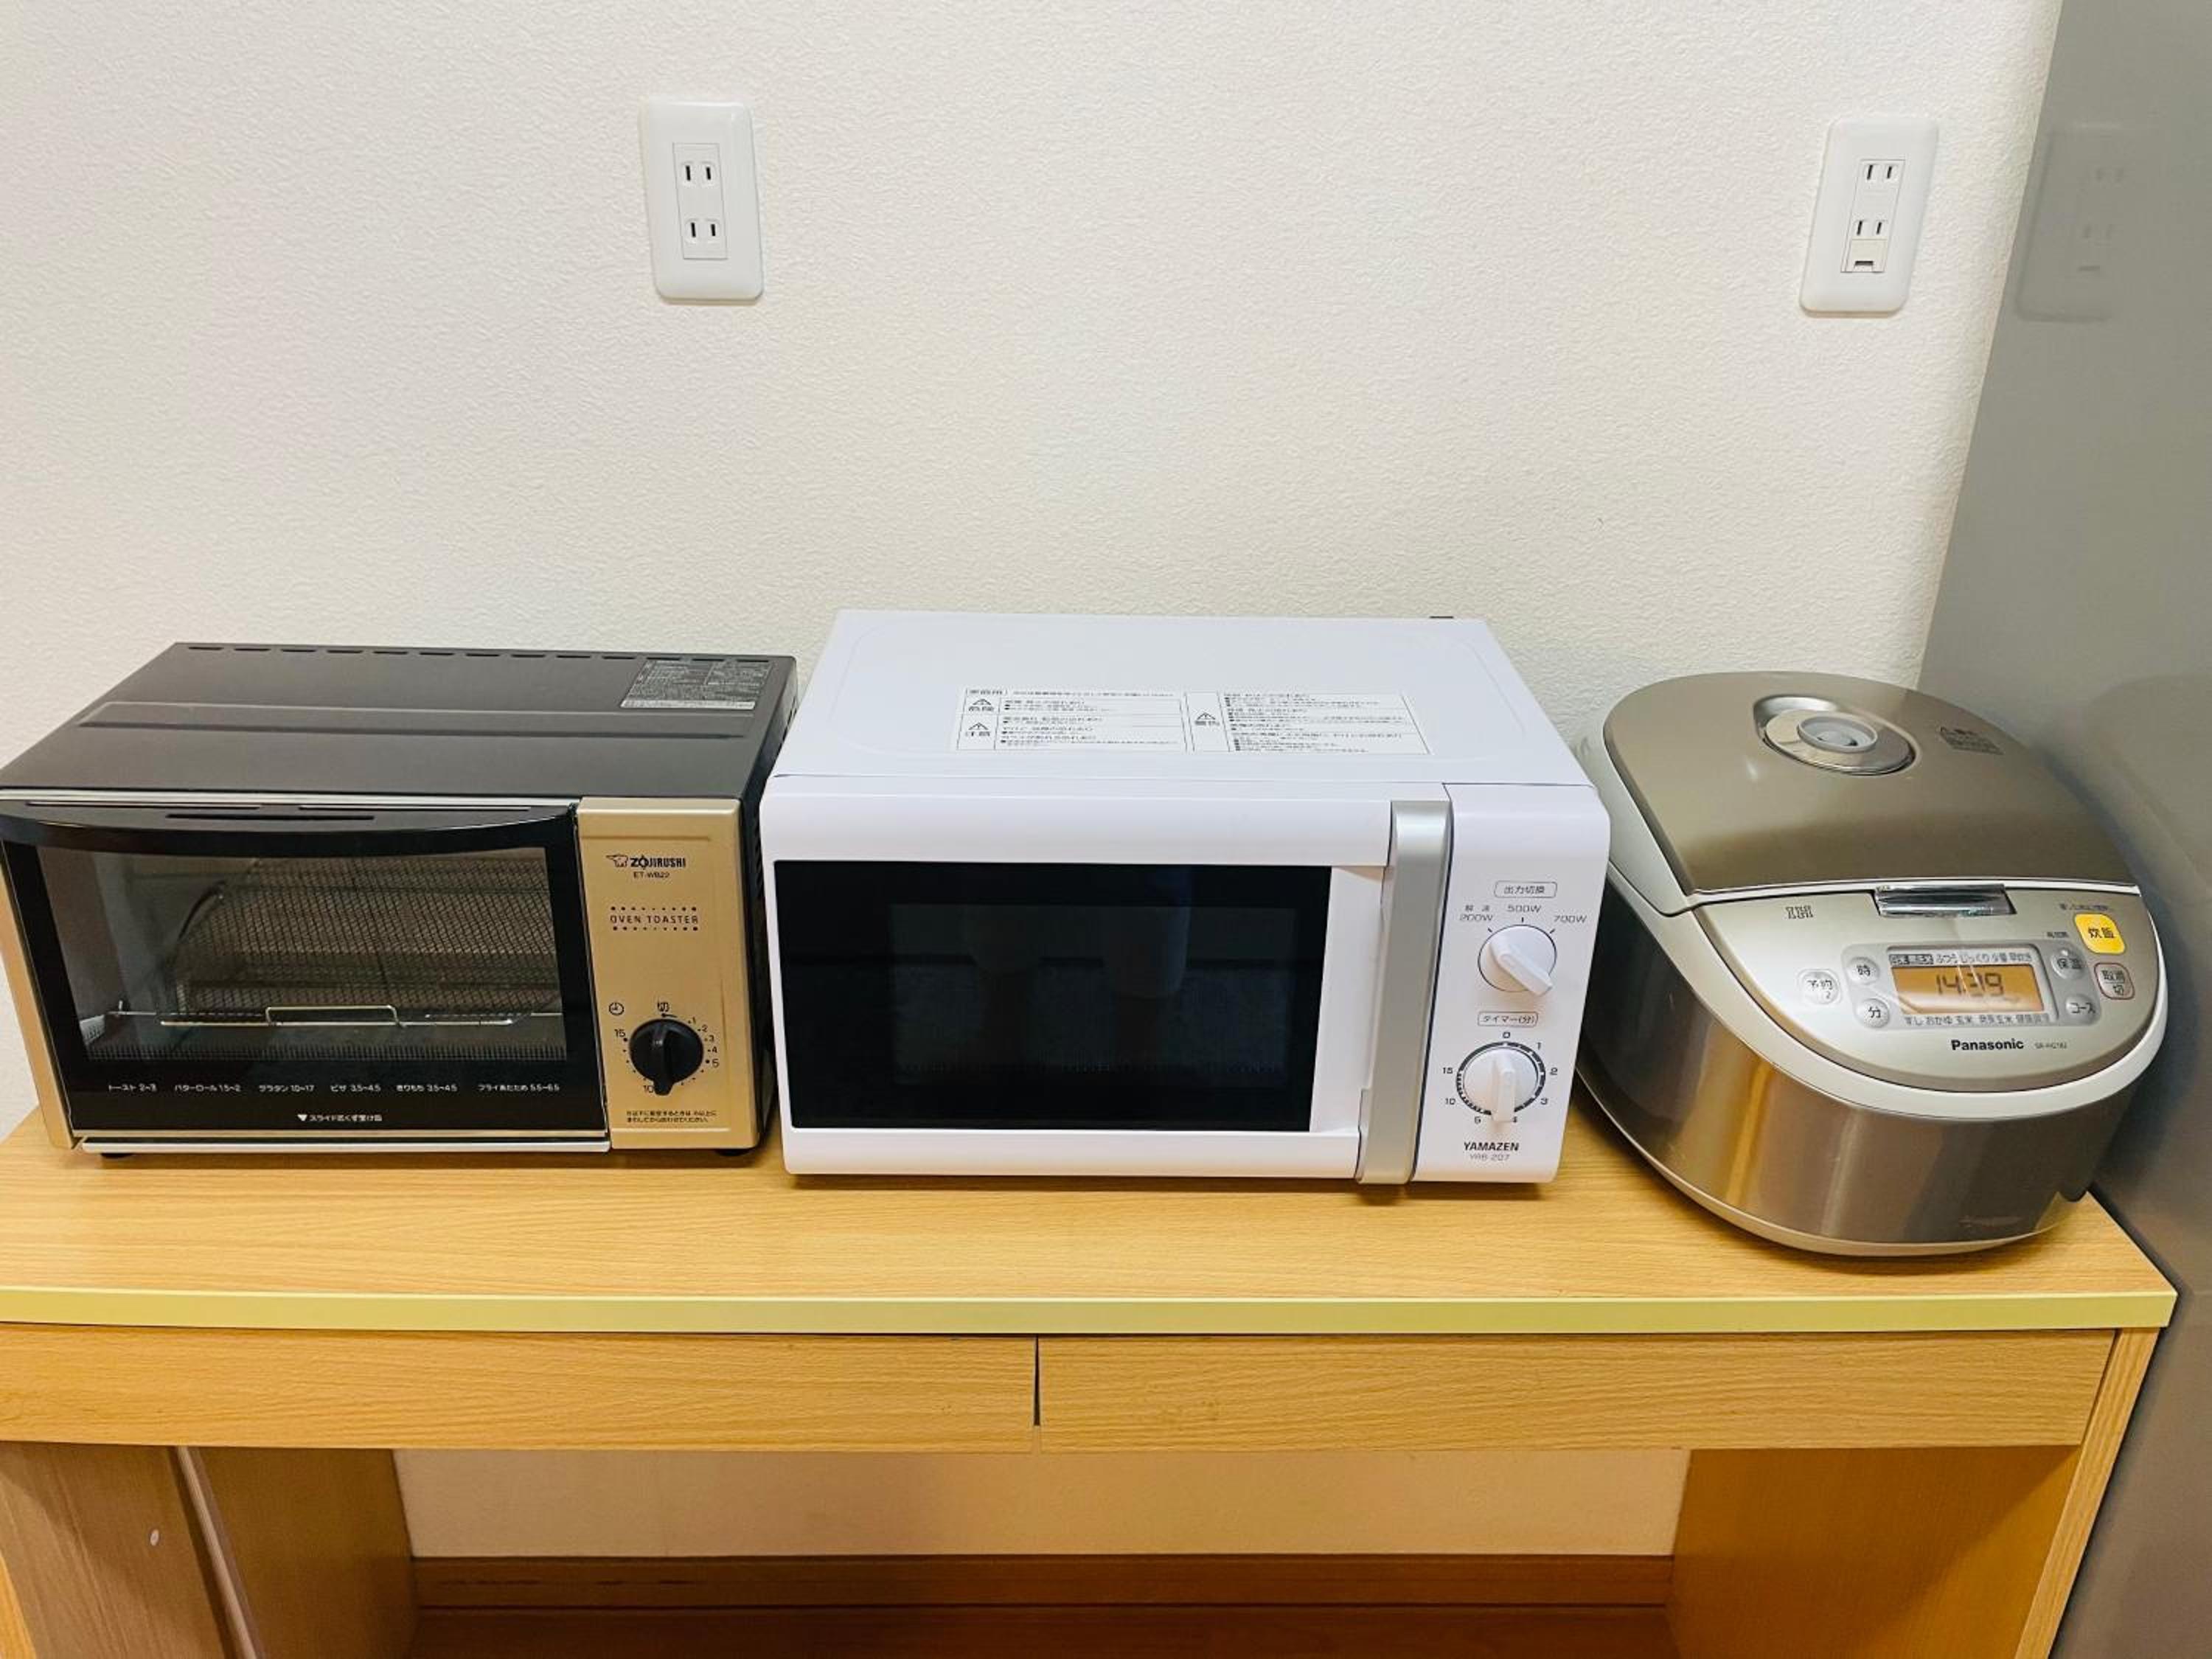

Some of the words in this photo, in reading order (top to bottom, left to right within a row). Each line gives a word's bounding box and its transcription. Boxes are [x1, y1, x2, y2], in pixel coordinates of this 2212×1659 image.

[630, 855, 686, 869] ZOJIRUSHI
[610, 915, 641, 924] OVEN
[647, 915, 698, 924] TOASTER
[614, 1029, 626, 1037] 15
[1951, 1038, 2025, 1051] Panasonic
[712, 1058, 720, 1068] 5
[1464, 1141, 1519, 1151] YAMAZEN
